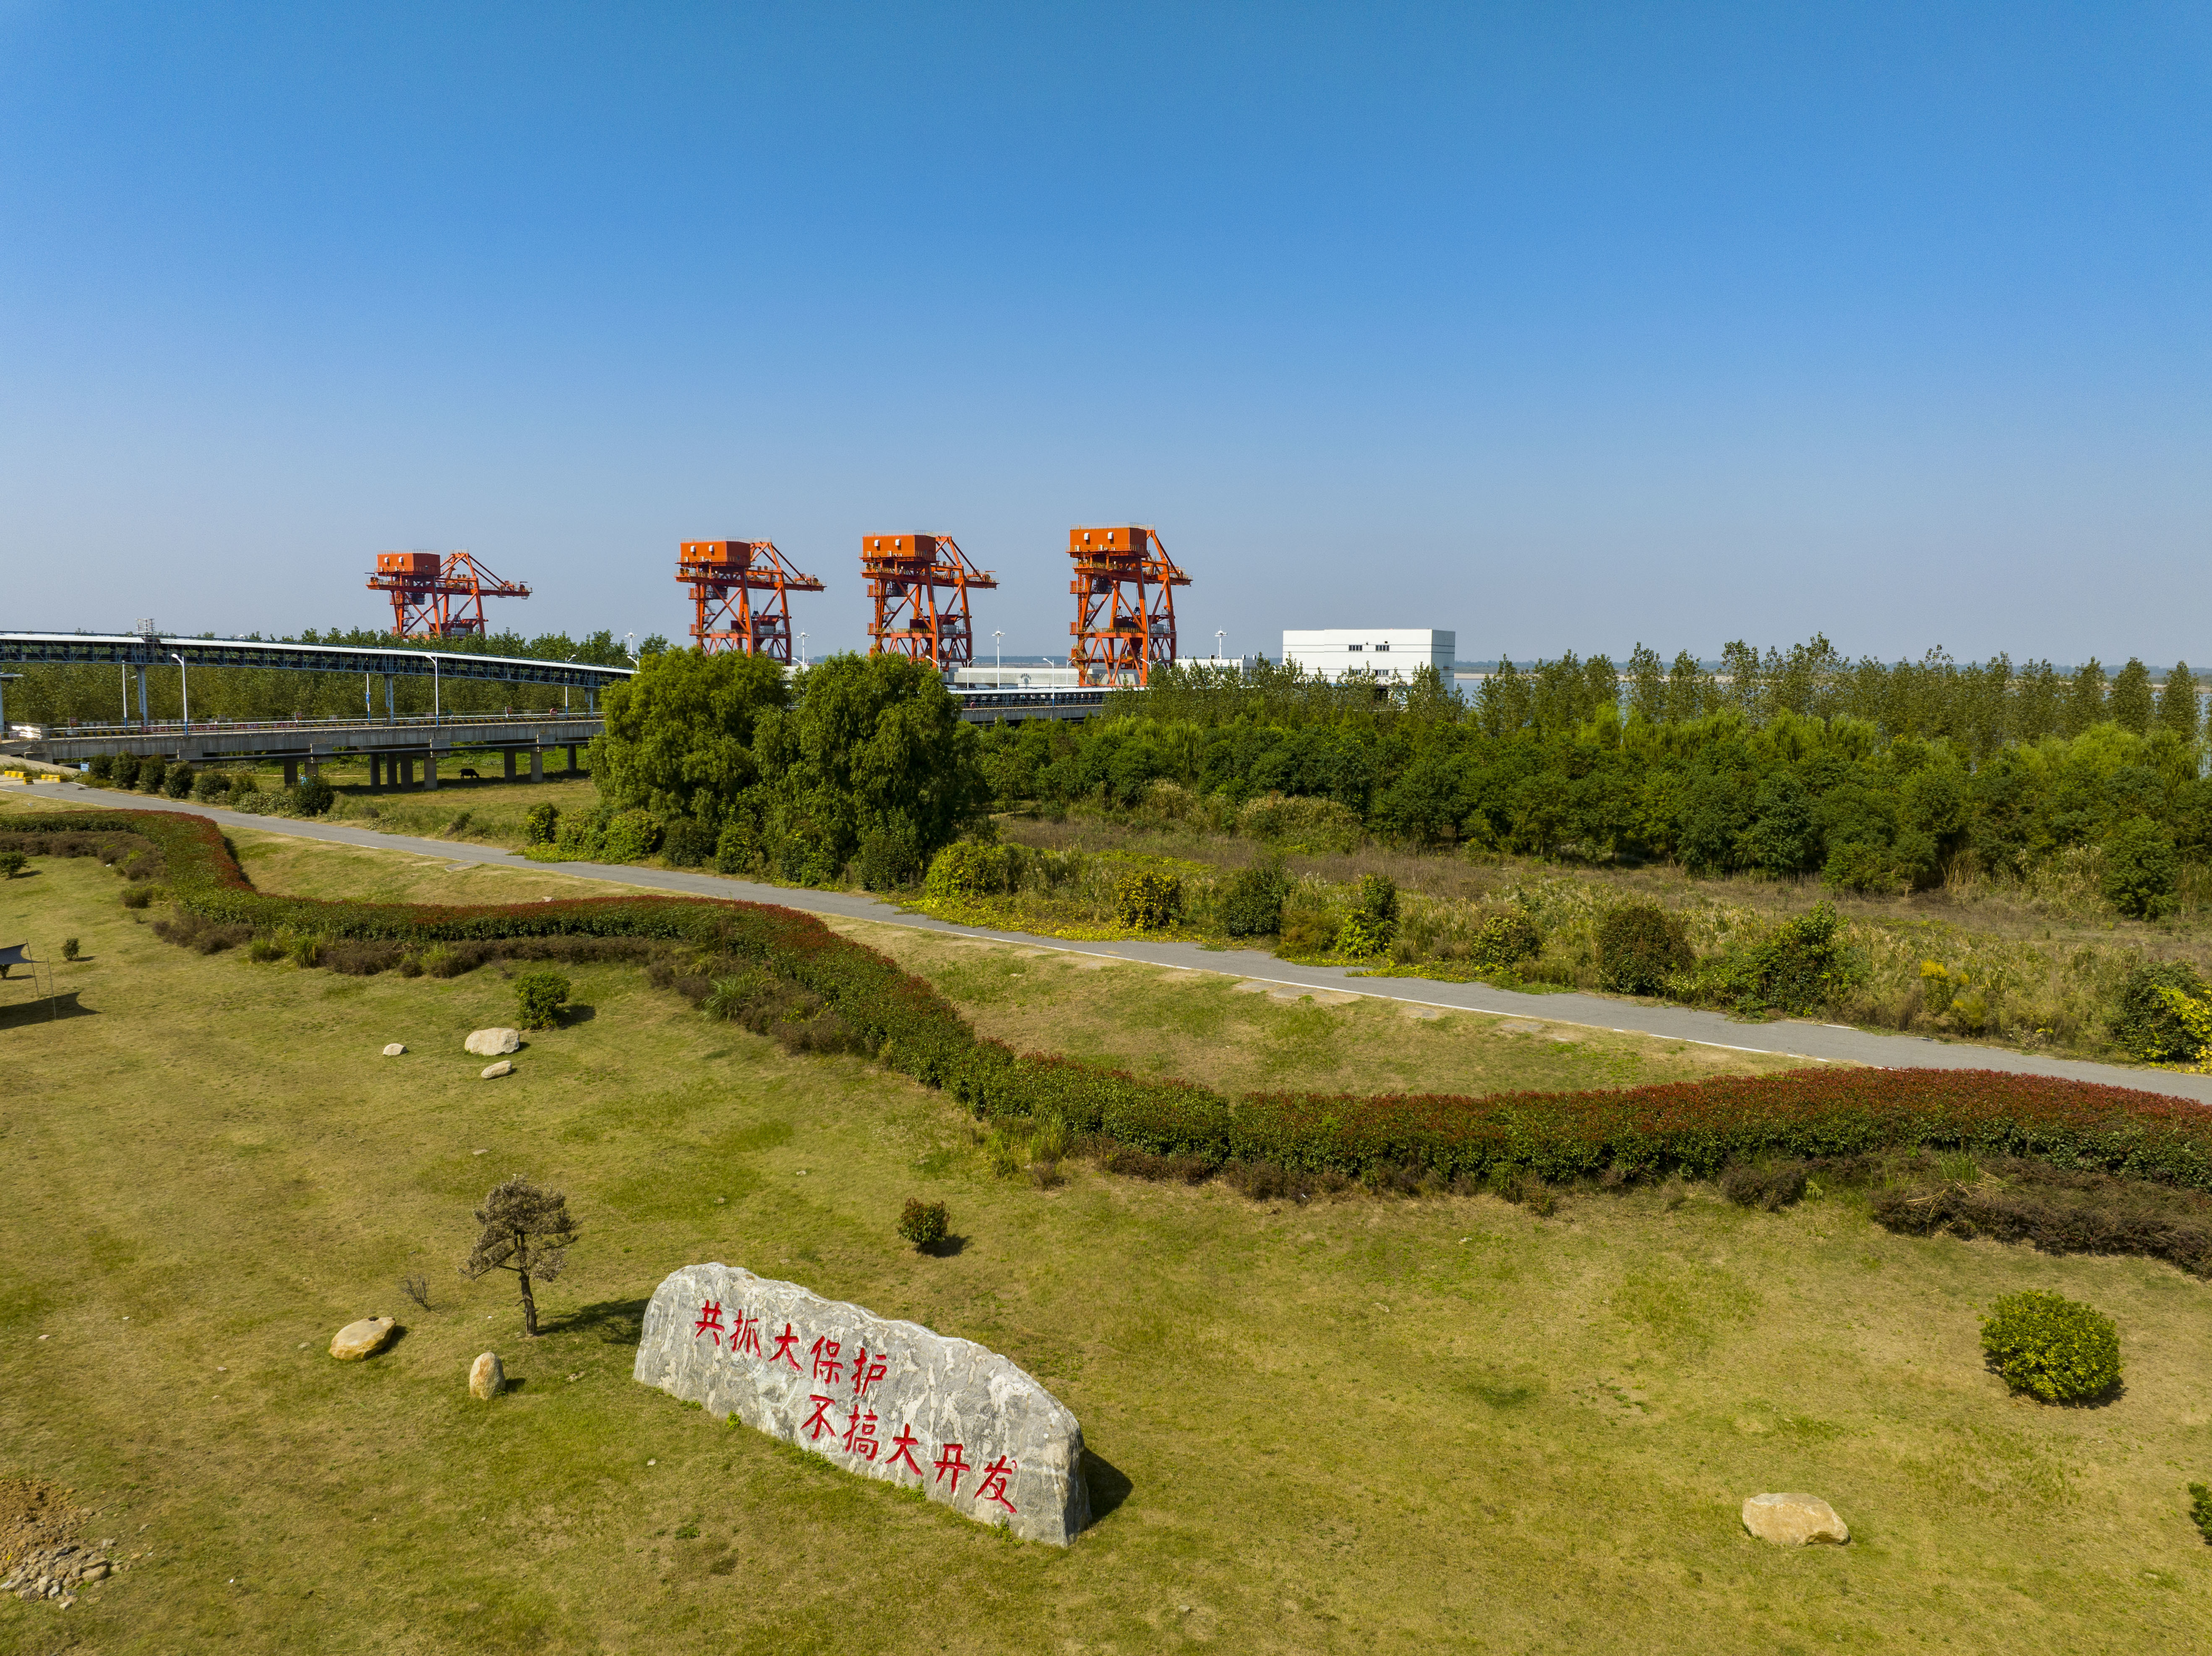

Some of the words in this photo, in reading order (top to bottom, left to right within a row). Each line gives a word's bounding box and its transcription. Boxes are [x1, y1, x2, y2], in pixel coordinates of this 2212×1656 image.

[695, 1300, 887, 1398] 共抓大保护
[801, 1394, 1017, 1513] 不搞大开发
